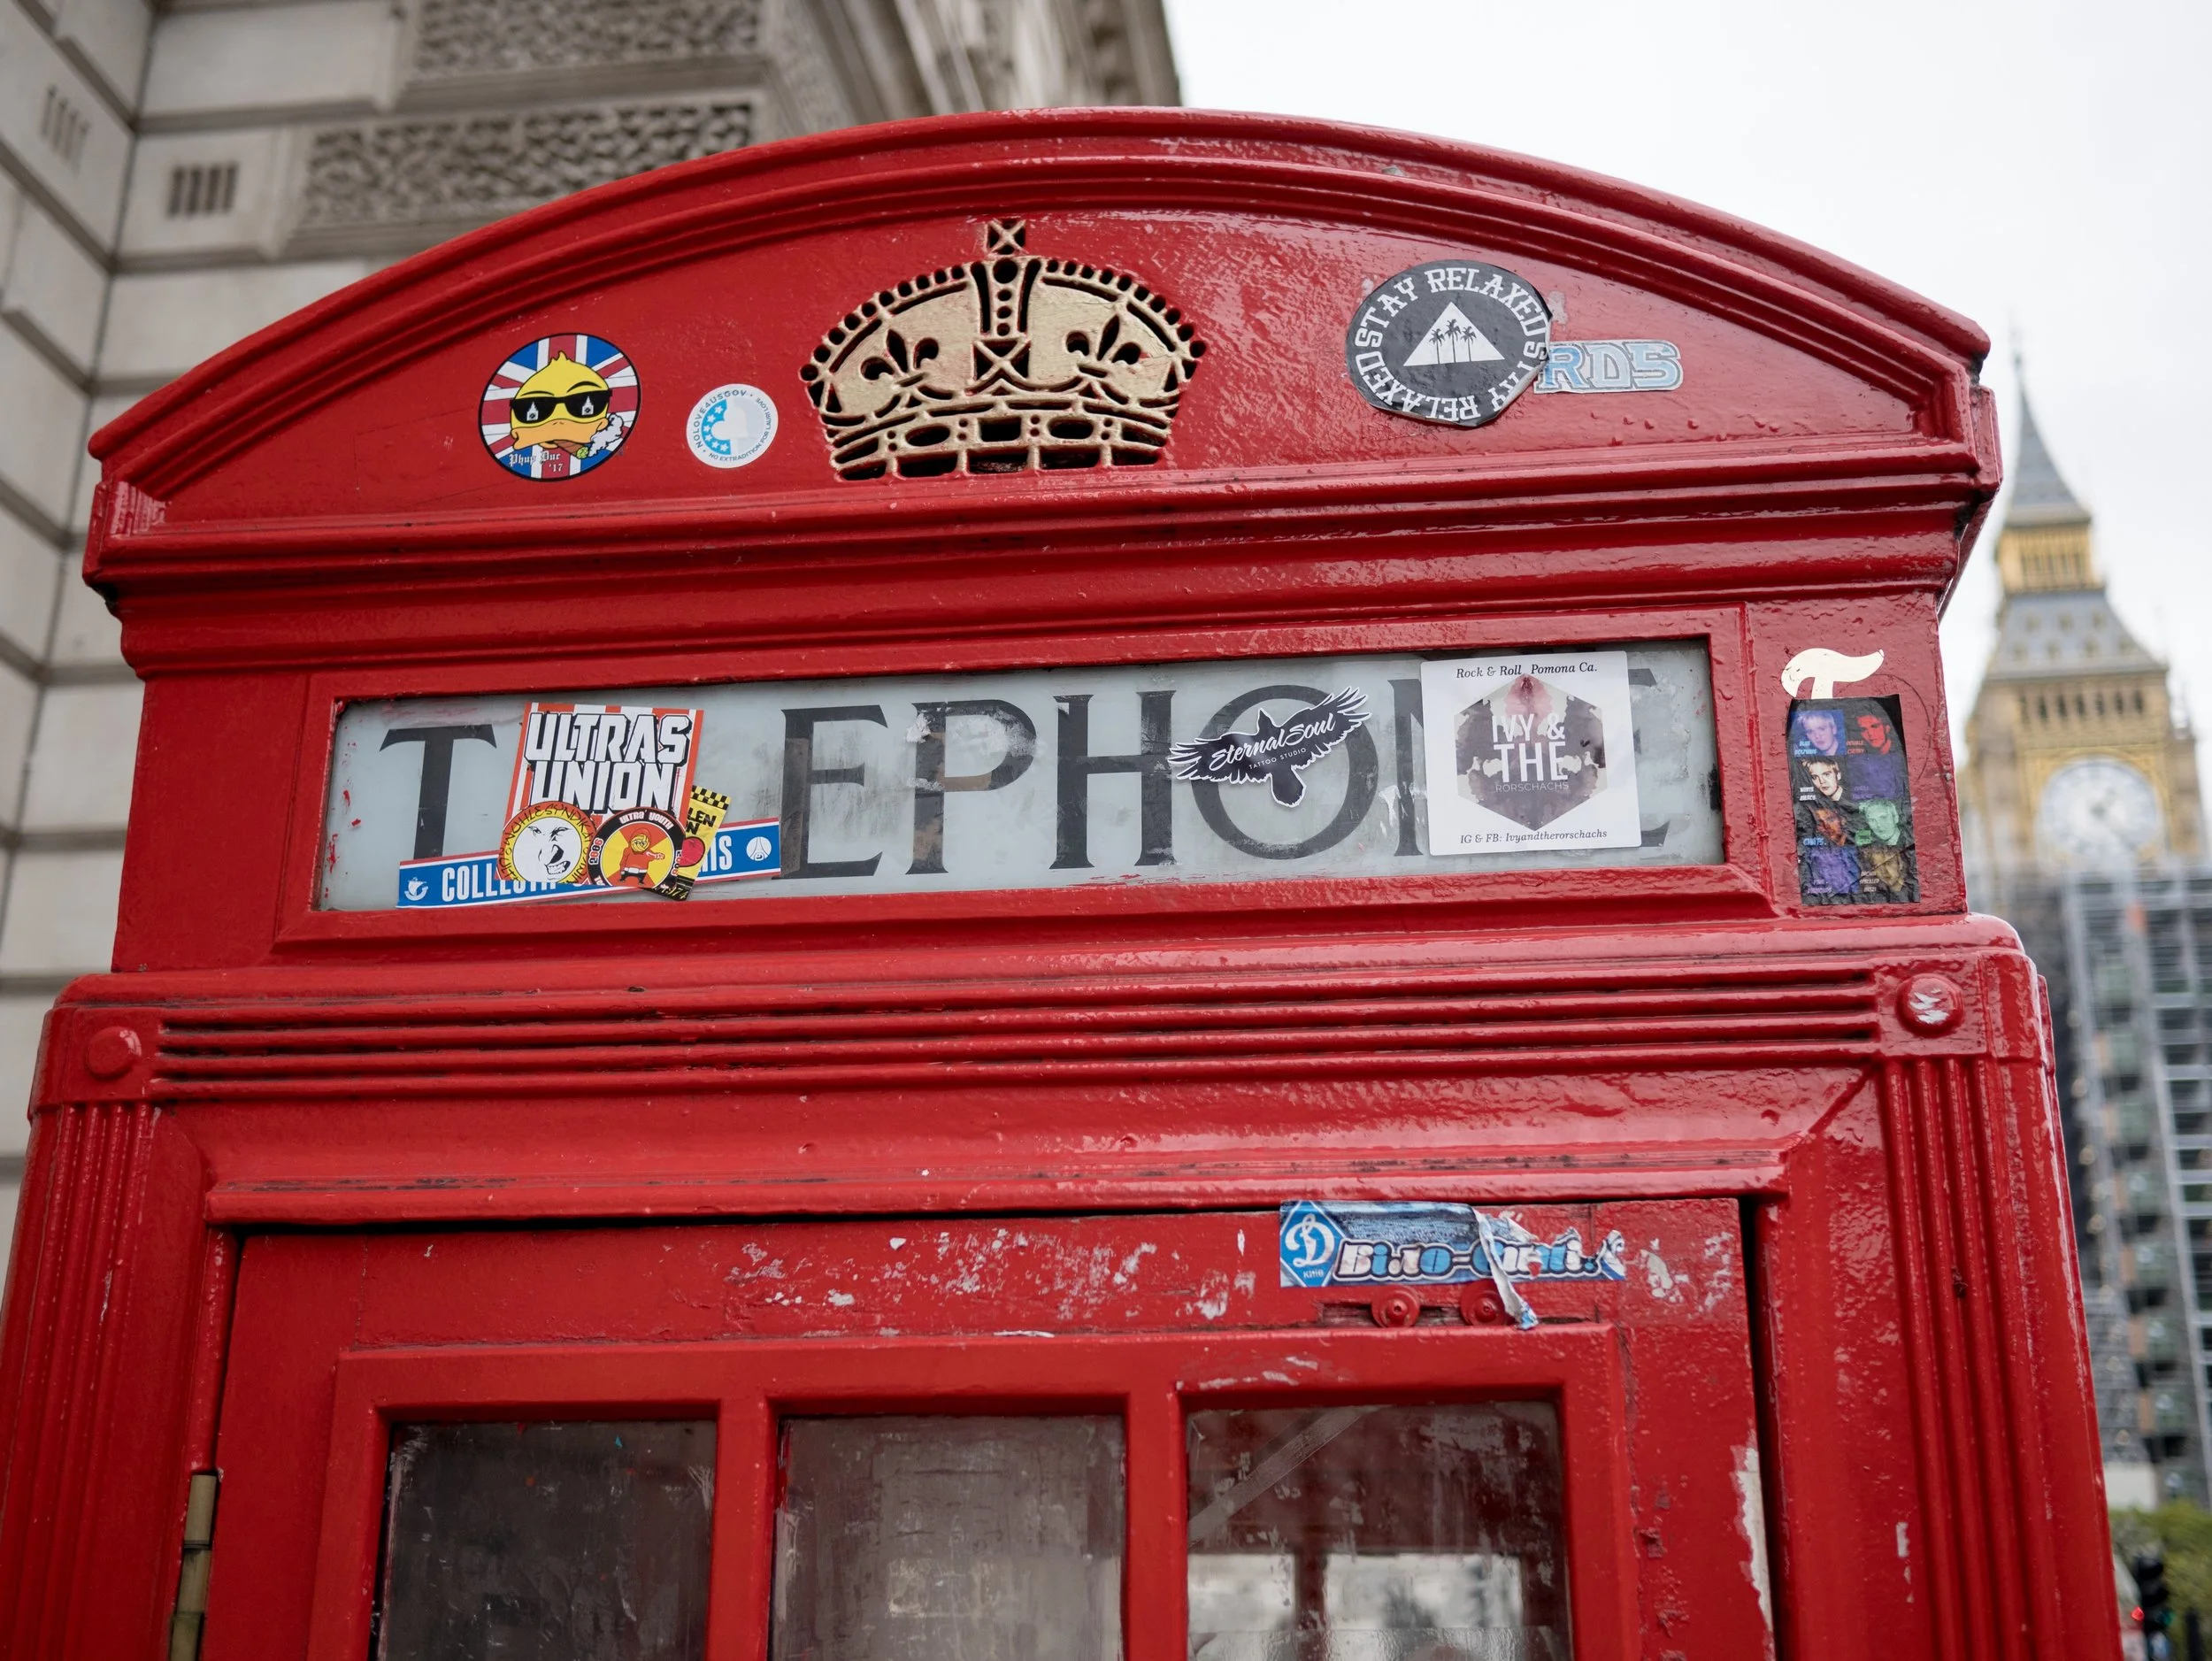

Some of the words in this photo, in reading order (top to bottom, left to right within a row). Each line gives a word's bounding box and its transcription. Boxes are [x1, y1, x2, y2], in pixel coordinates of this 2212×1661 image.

[1355, 276, 1418, 348] STAY
[1424, 267, 1550, 337] RELAXED
[719, 443, 762, 461] EXTRADITION
[1456, 666, 1483, 679] Rock
[1486, 666, 1496, 677] &
[1500, 665, 1522, 676] Roll
[1531, 664, 1576, 674] Pomona
[1579, 662, 1598, 673] Ca.
[525, 712, 693, 767] ULTRAS
[1492, 713, 1534, 742] IVY
[1547, 712, 1566, 740] &
[1248, 757, 1278, 770] TATTOO
[1279, 747, 1307, 761] STUDIO
[1493, 741, 1569, 783] THE
[380, 667, 1670, 881] TEPHO
[531, 760, 677, 813] UNION
[1495, 781, 1570, 793] RORSCHACHS
[588, 836, 604, 865] 2006
[1460, 834, 1472, 844] IG
[1475, 834, 1483, 843] &
[1486, 833, 1502, 842] FB:
[1505, 828, 1608, 843] Ivyandtherorschachs
